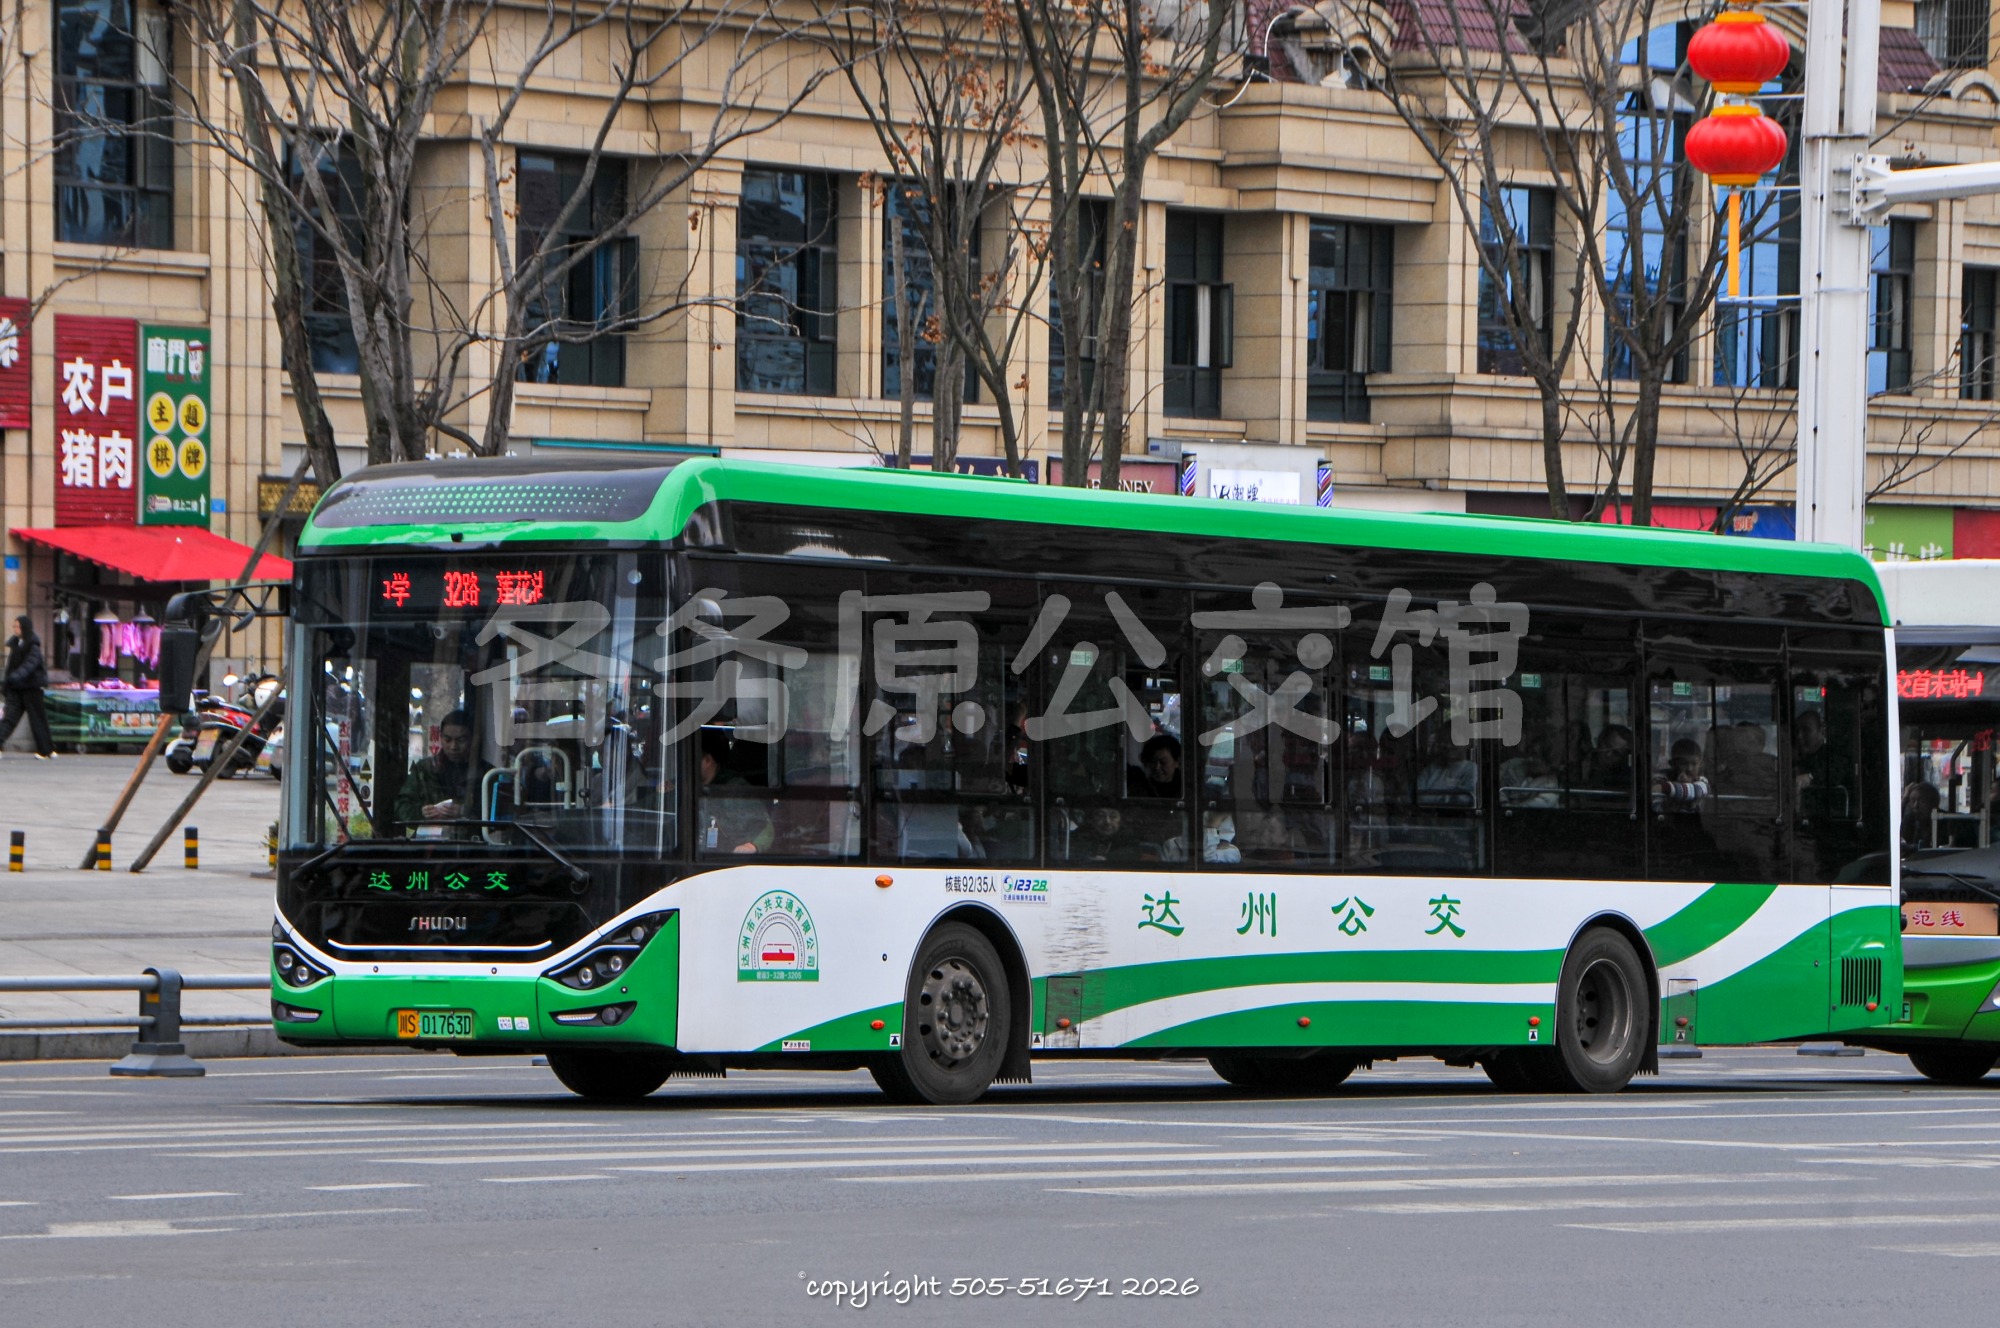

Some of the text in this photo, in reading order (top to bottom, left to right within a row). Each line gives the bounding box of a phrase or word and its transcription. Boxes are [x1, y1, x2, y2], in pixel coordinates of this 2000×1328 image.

[61, 357, 133, 416] 农户
[61, 429, 133, 488] 猪肉
[443, 571, 480, 607] 32路
[367, 871, 510, 891] 达州公交
[945, 875, 997, 893] 核载92/35人
[408, 916, 467, 931] SHUDU
[1138, 890, 1465, 938] 达州公交
[1912, 910, 1965, 927] 范线
